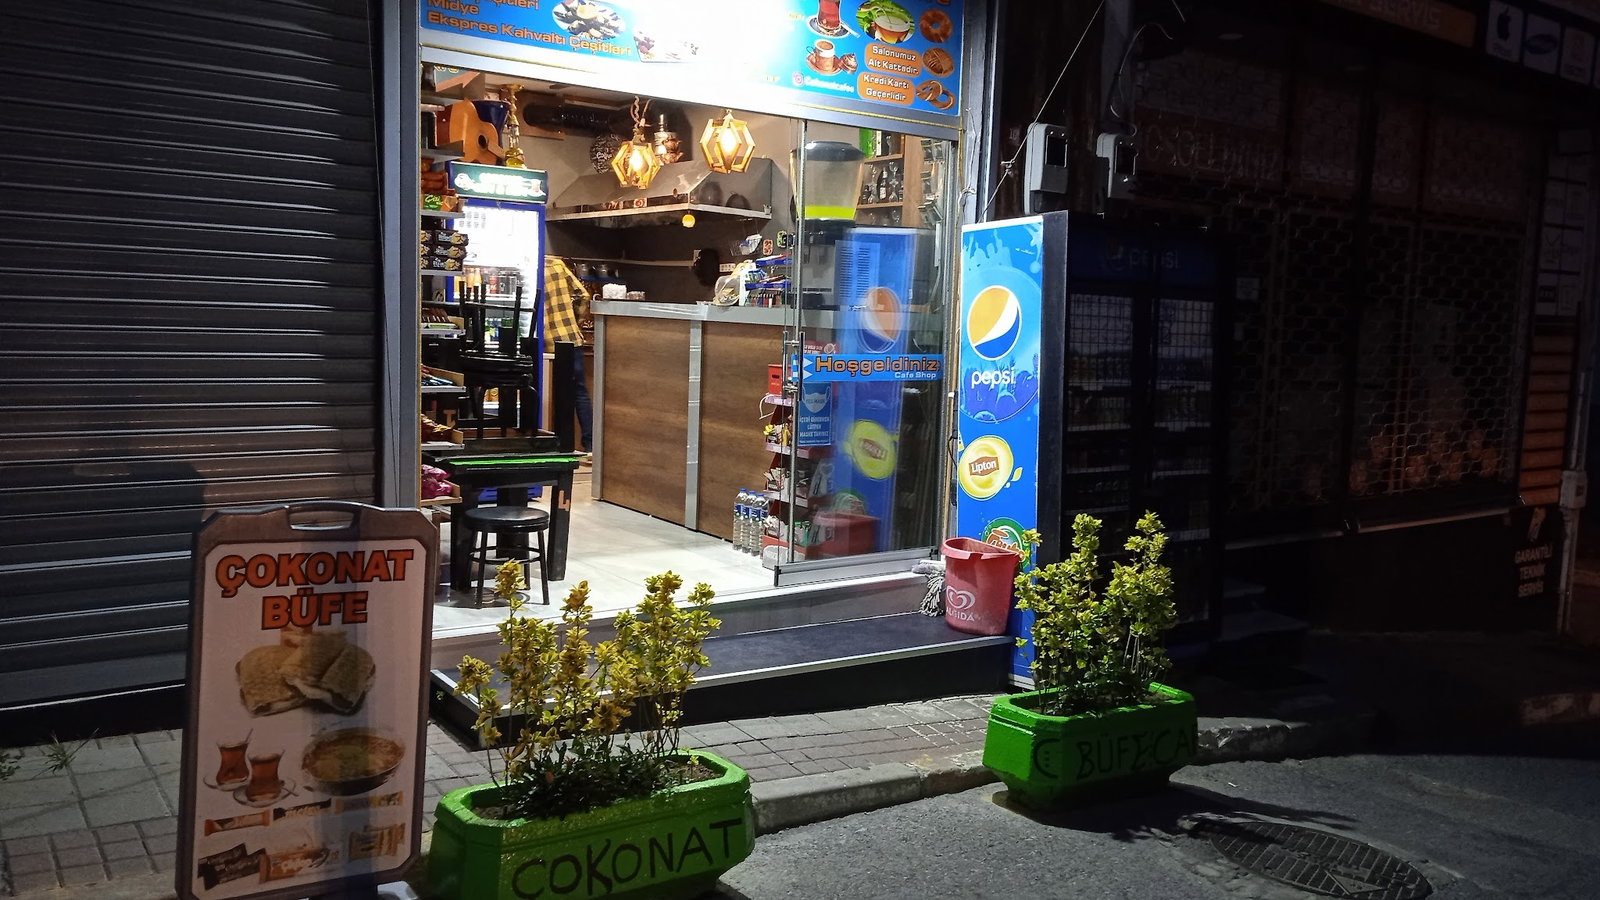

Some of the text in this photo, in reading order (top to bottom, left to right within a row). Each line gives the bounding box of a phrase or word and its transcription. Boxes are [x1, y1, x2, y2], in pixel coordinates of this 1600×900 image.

[428, 0, 480, 16] Midye
[427, 11, 632, 57] Ekspres Kahvaltı Çeşitleri
[872, 45, 917, 62] Salonumuz
[868, 58, 881, 69] Alt
[863, 74, 887, 86] Kredi
[887, 78, 909, 89] Kartı
[815, 356, 938, 377] Hoşgeldiniz
[894, 371, 937, 380] Cafe Shop
[971, 367, 1016, 389] pepsi
[970, 460, 997, 475] Lipton
[215, 548, 415, 598] ÇOKONAT
[261, 587, 369, 630] BÜFE
